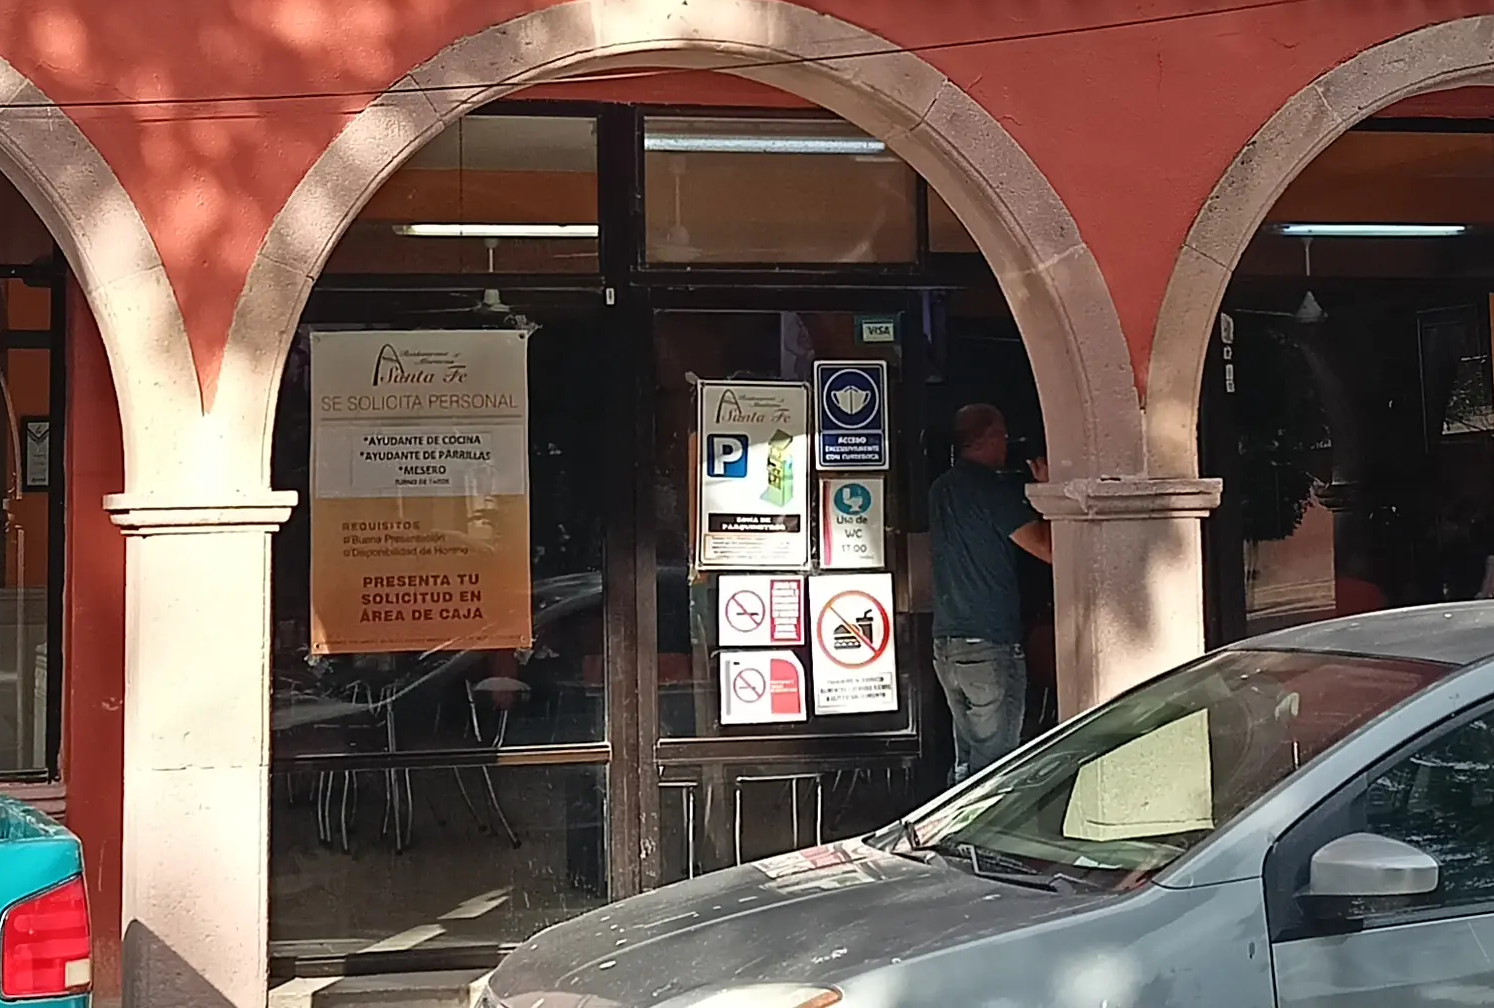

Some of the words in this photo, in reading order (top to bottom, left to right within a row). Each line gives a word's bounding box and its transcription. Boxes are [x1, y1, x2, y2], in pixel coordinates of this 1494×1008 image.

[867, 326, 890, 336] VISA
[380, 366, 435, 384] Santa
[443, 365, 468, 384] Fe
[320, 396, 342, 412] SE
[347, 395, 423, 411] SOLICITA
[428, 393, 518, 409] PERSONAL
[427, 435, 439, 445] DE
[442, 435, 481, 445] COCINA
[423, 451, 436, 461] DE
[439, 450, 491, 461] PARRILLAS
[856, 515, 868, 524] de
[342, 521, 421, 531] REQUISITOS
[845, 529, 863, 538] WC
[352, 535, 382, 545] Buena
[842, 544, 867, 553] 1700
[363, 575, 451, 588] PRESENTA
[458, 573, 480, 585] TU
[361, 592, 453, 605] SOLICITUD
[460, 591, 481, 603] EN
[360, 608, 405, 623] ÁREA
[412, 610, 433, 622] DE
[440, 608, 483, 621] CAJA
